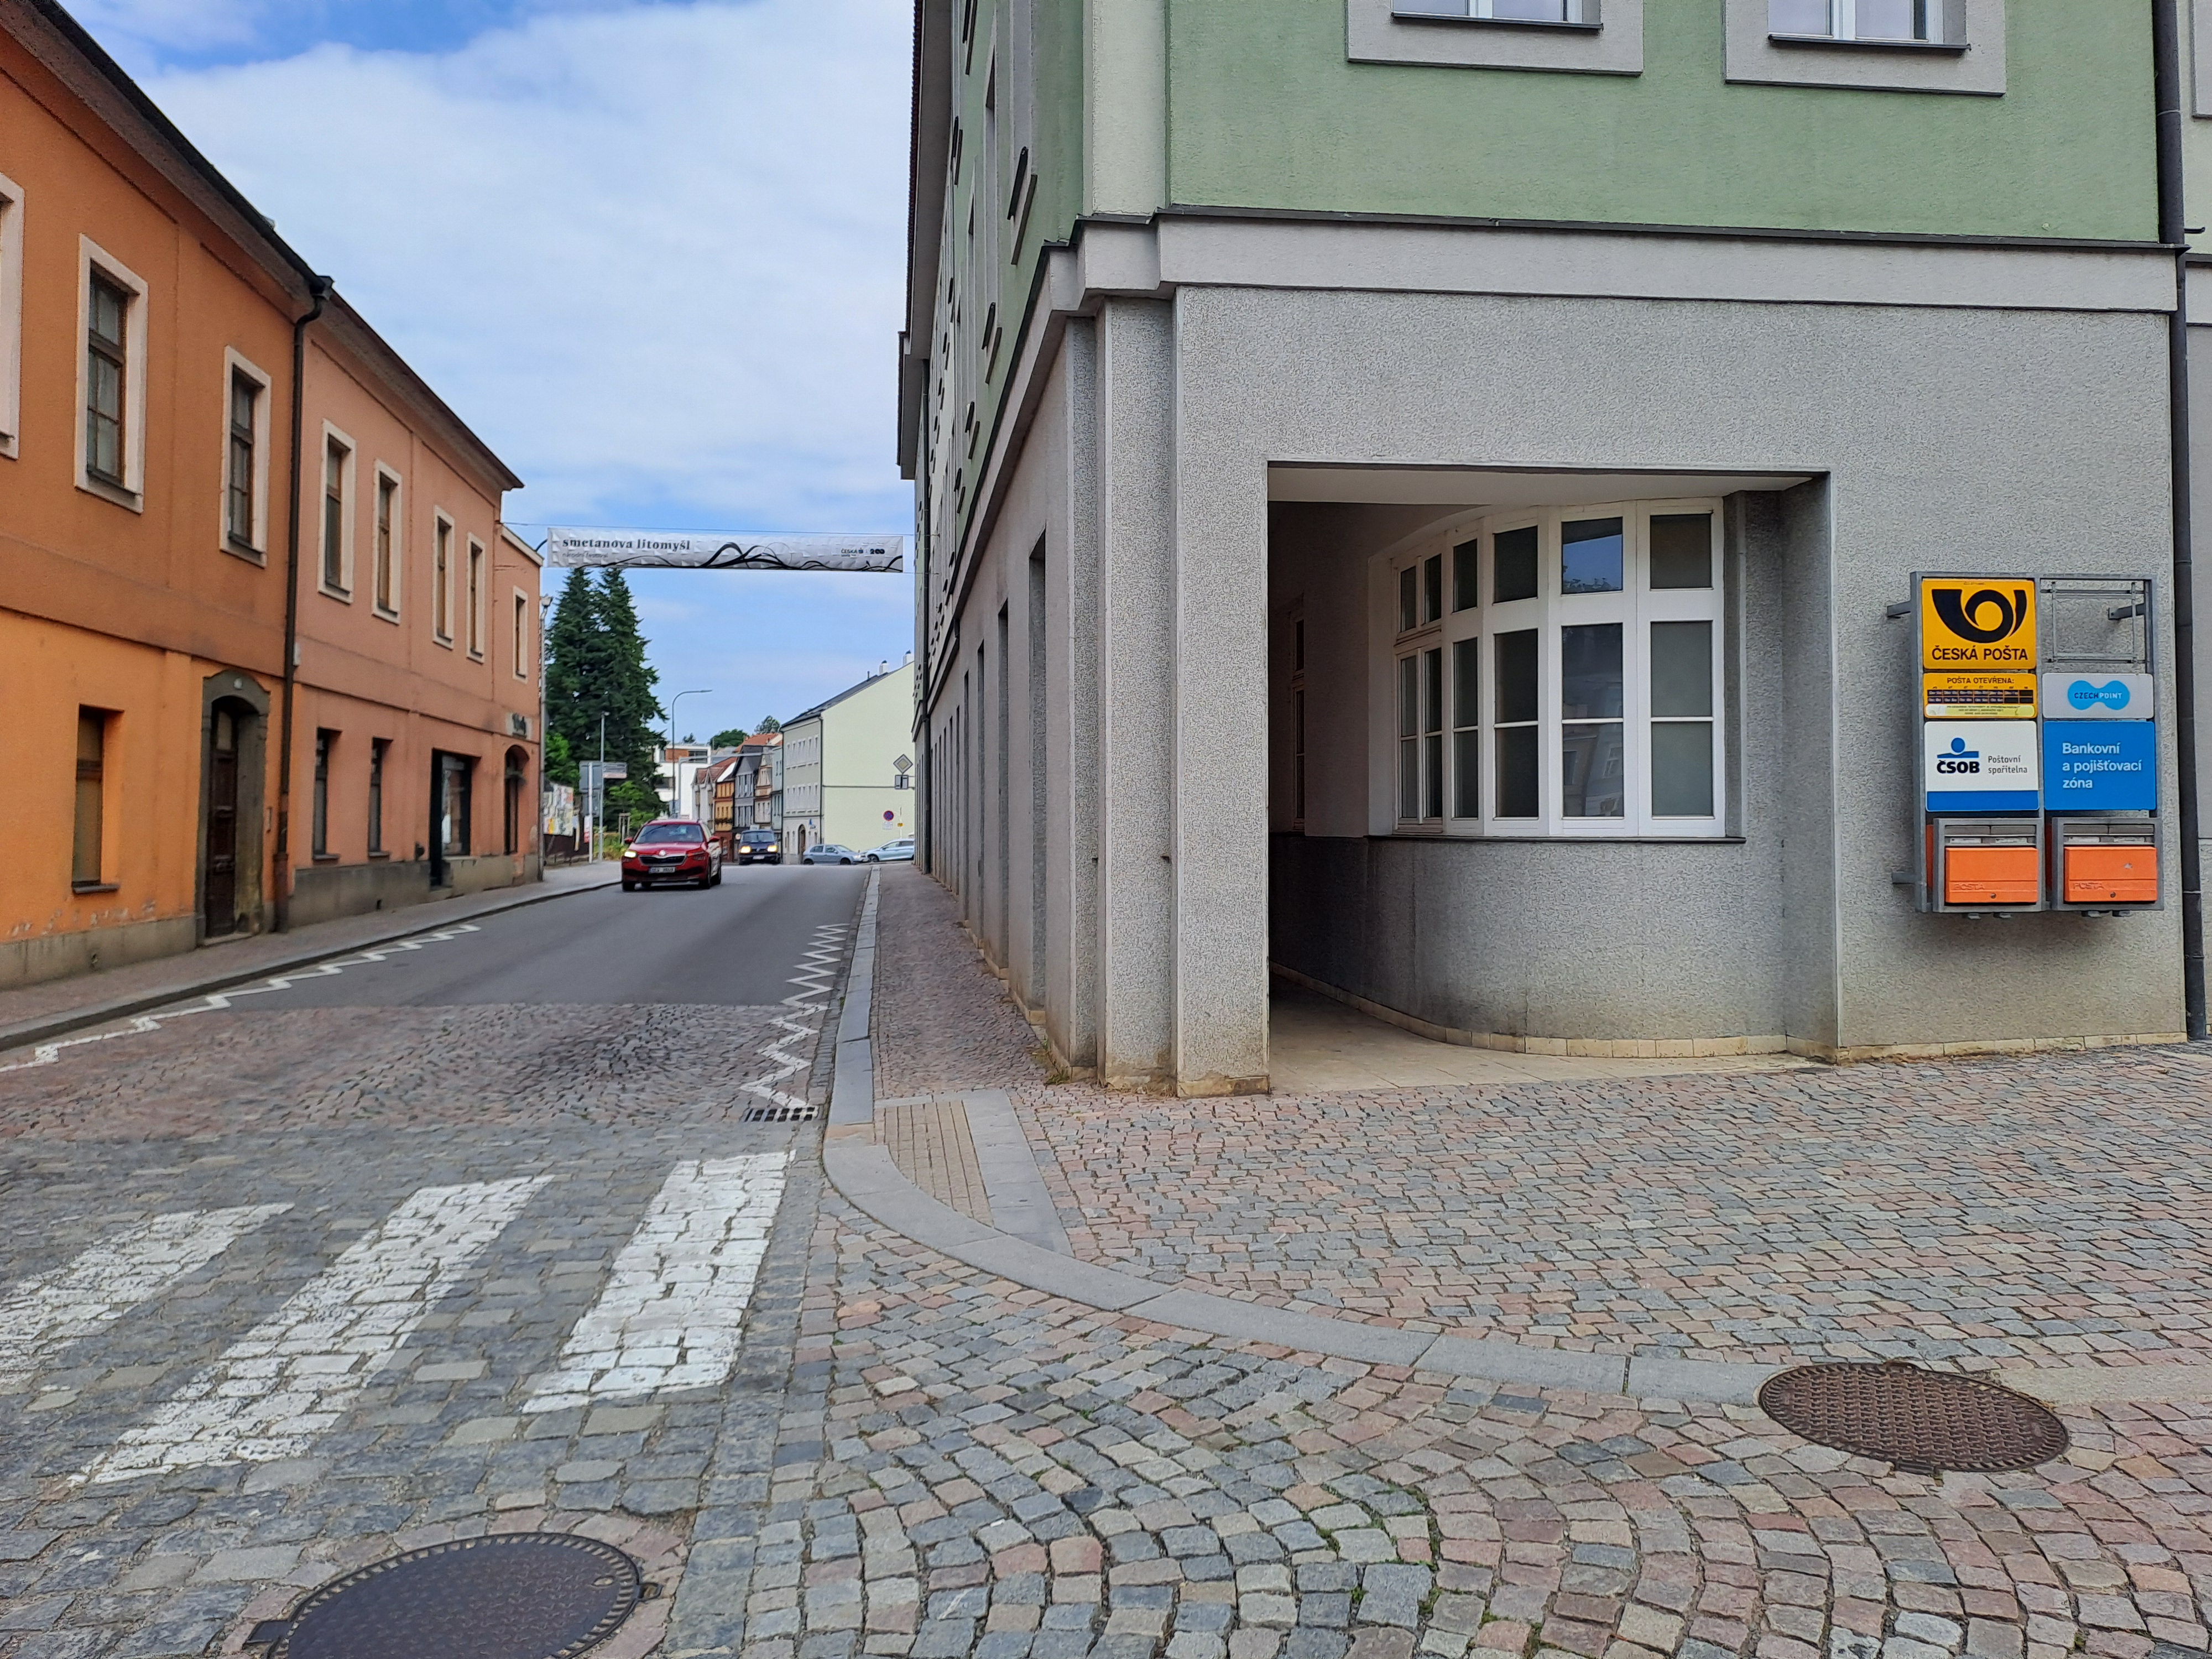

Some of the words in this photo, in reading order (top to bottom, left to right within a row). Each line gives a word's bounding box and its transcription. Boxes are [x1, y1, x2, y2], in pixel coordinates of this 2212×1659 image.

[562, 539, 633, 549] smetanova
[637, 539, 691, 552] litomyšl
[1932, 645, 1979, 661] ČESKÁ
[1984, 645, 2028, 660] POŠTA
[2062, 742, 2121, 754] Bankovní
[1988, 755, 2021, 763] Poštovní
[1937, 760, 1980, 774] ČSOB
[1988, 765, 2028, 775] spořitelna
[2062, 762, 2070, 771] a
[2074, 759, 2142, 774] pojišťovací
[2063, 777, 2093, 789] zóna
